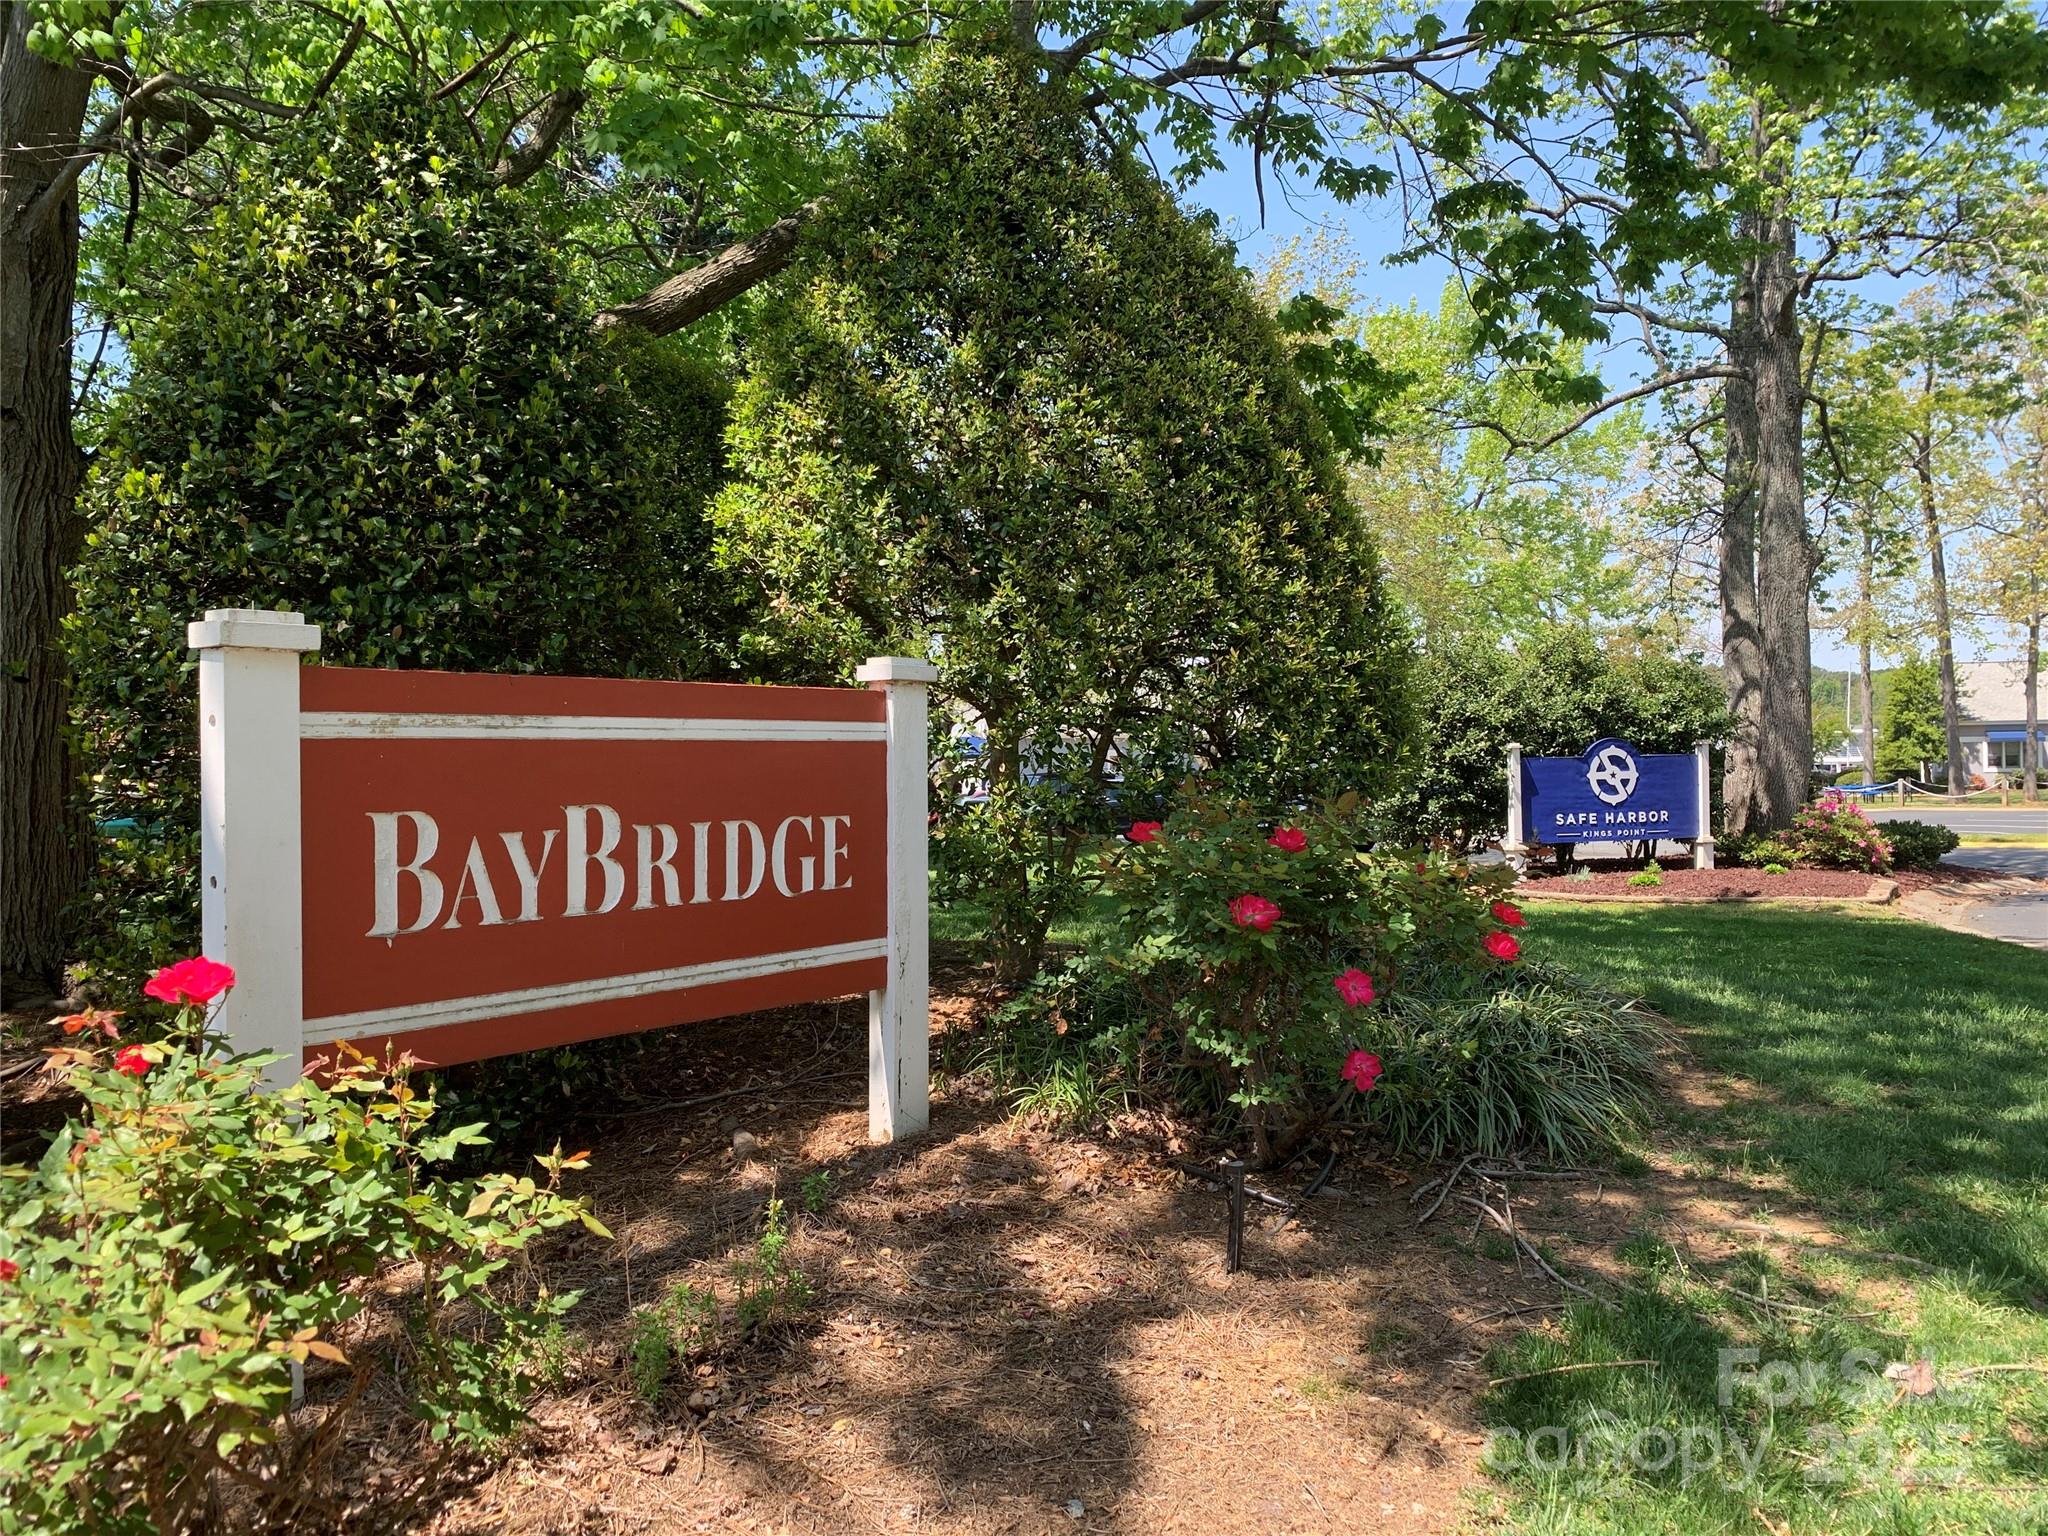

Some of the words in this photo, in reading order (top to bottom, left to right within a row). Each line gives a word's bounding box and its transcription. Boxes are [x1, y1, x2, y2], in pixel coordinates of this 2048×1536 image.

[1555, 812, 1598, 825] SAFE
[1605, 810, 1669, 824] HARBOR
[1583, 830, 1613, 838] KINGS
[1617, 829, 1646, 837] POINT
